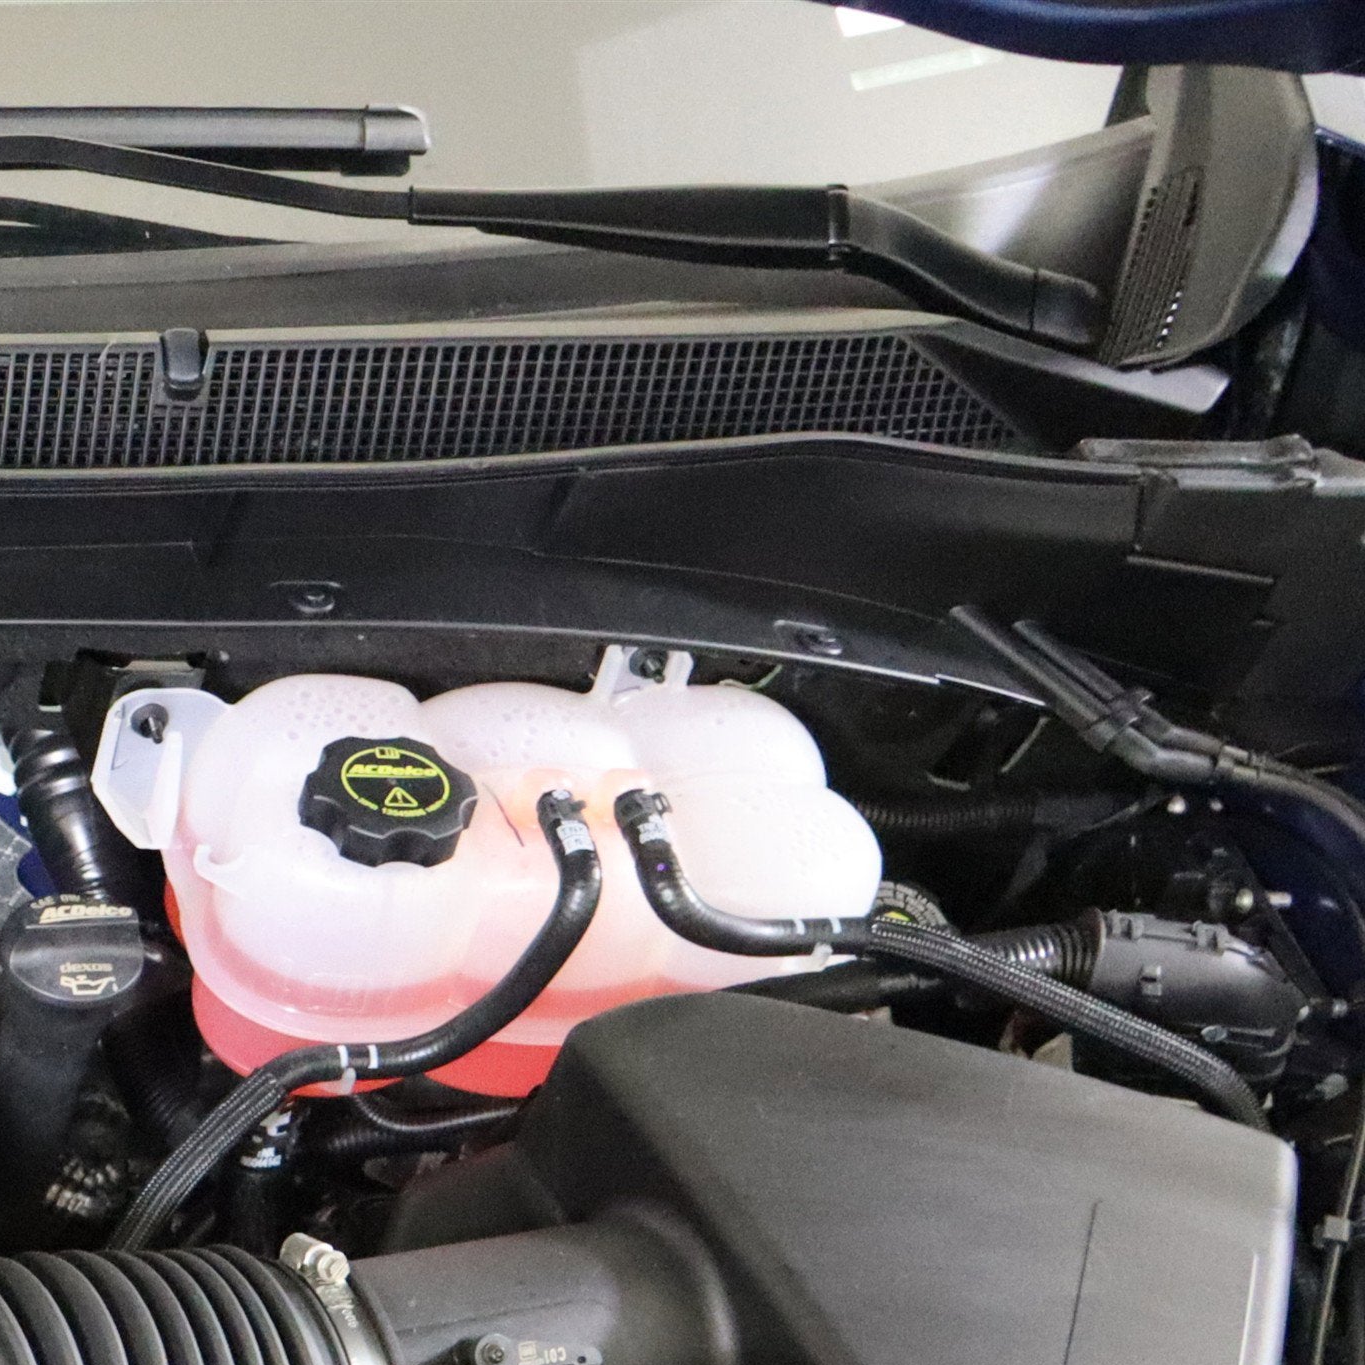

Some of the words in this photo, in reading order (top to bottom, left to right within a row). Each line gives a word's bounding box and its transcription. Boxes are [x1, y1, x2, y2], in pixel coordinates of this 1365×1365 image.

[349, 763, 438, 777] ACDelco
[40, 903, 133, 922] ACDelco
[59, 962, 114, 973] dexos
